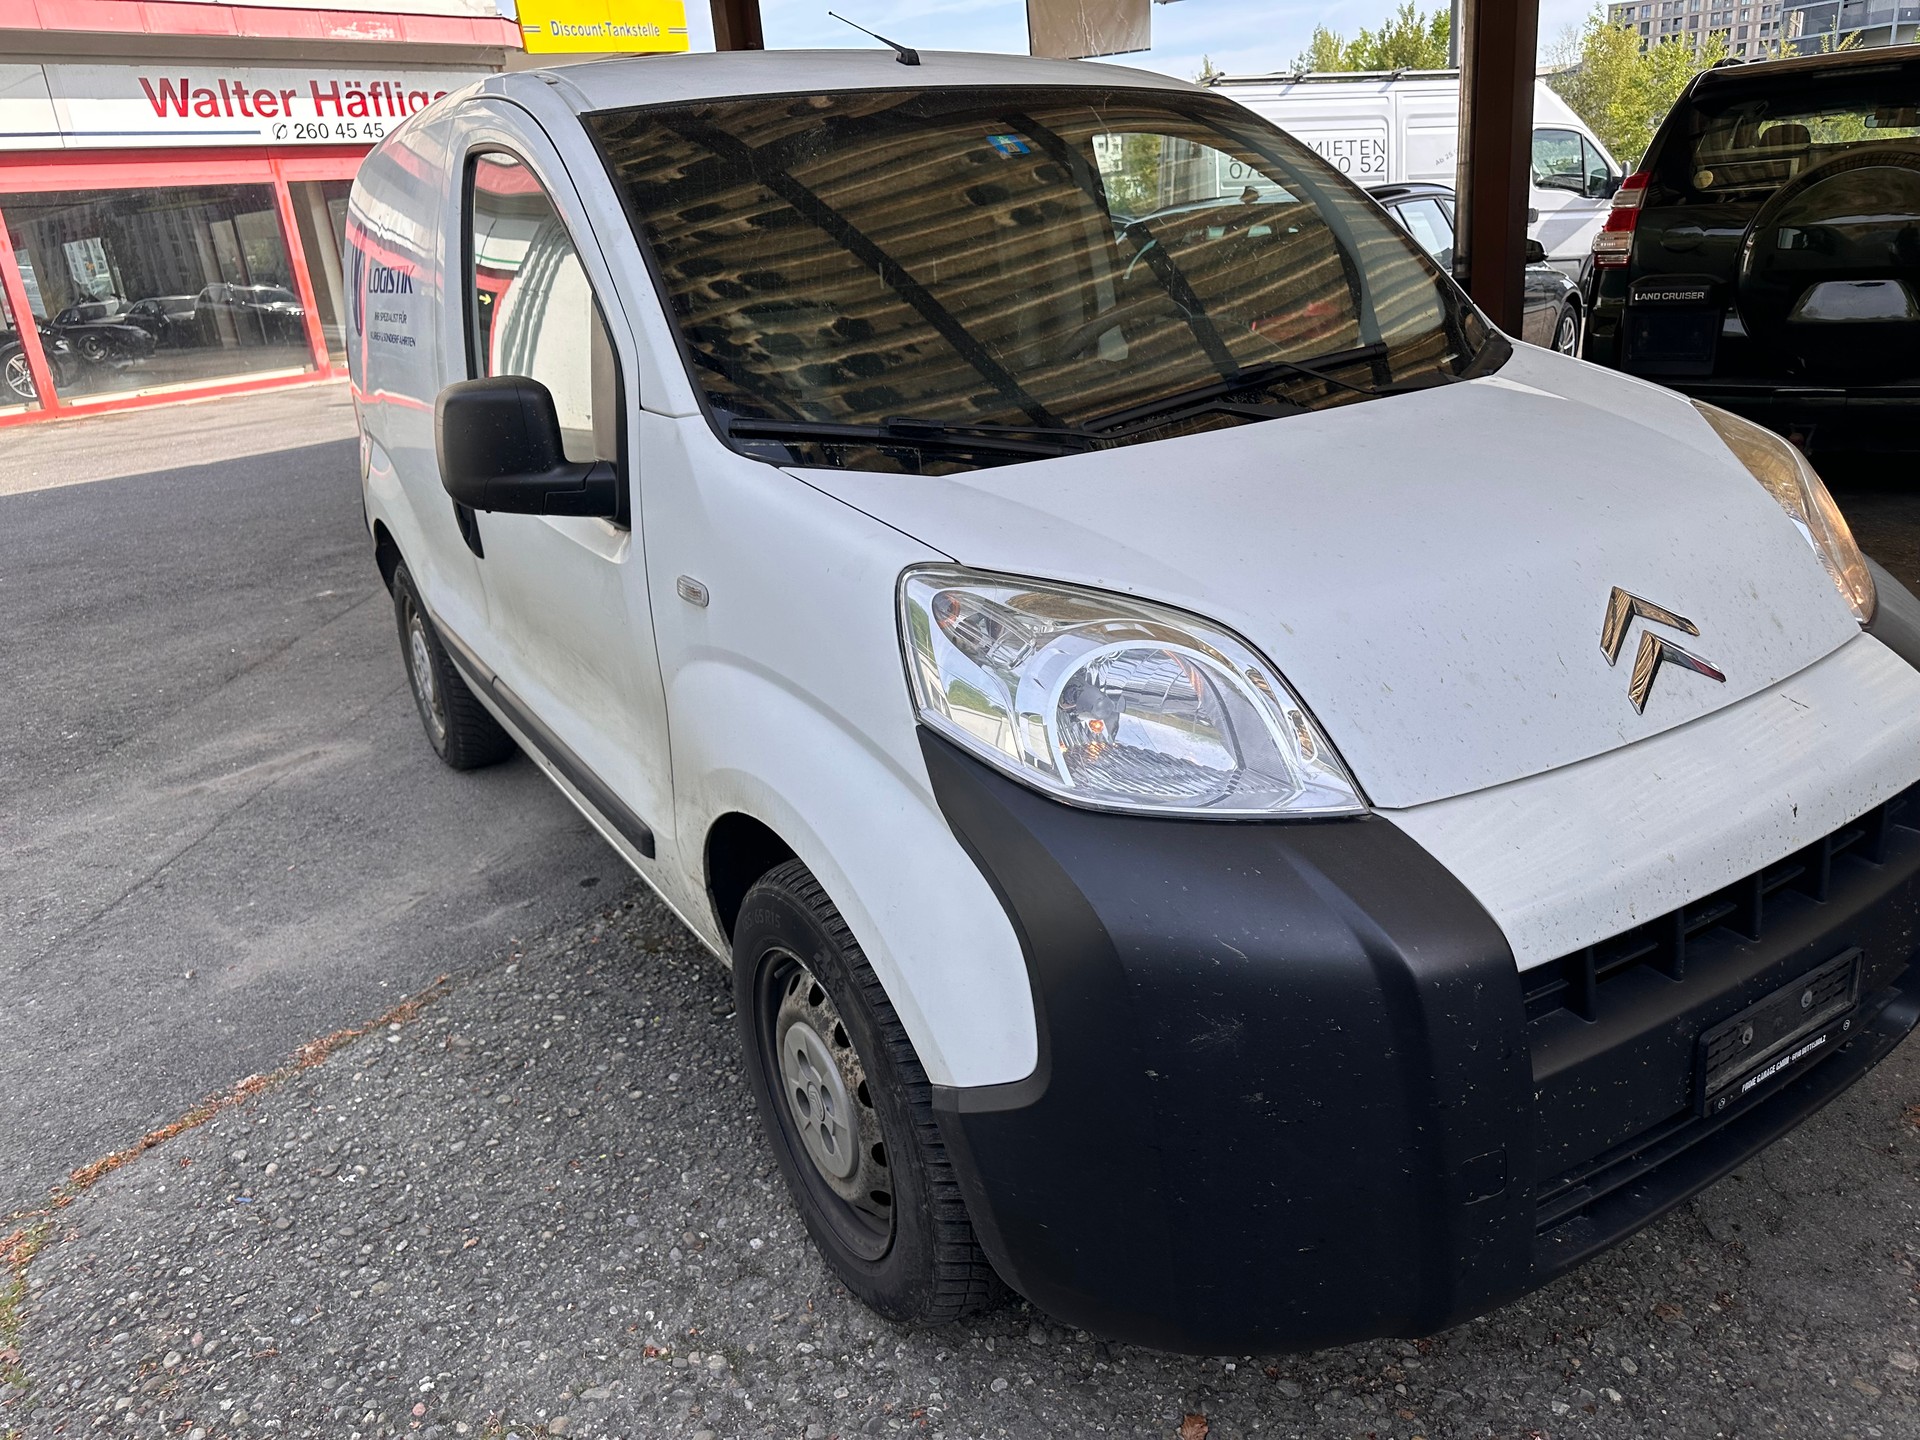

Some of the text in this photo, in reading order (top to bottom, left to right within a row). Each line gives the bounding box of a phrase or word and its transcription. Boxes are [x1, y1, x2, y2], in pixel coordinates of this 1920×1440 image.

[550, 20, 660, 37] Discount-Tankstelle
[138, 77, 297, 118] Walter
[294, 122, 385, 139] 260 45 45
[1307, 139, 1385, 156] MIETEN
[1360, 155, 1385, 173] 52
[368, 265, 416, 294] LOGISTIK
[1634, 291, 1705, 301] LAND CRUISER
